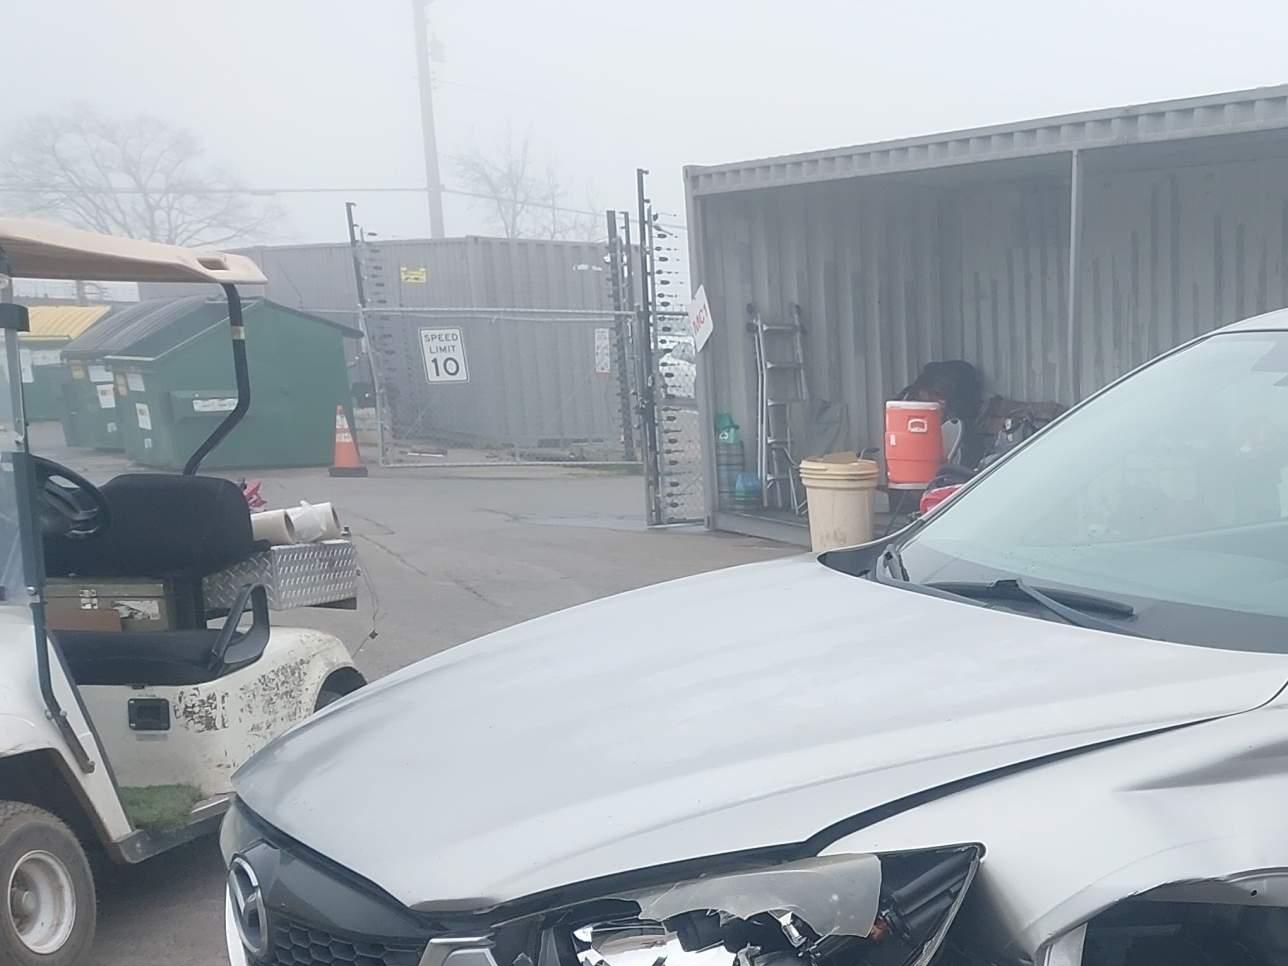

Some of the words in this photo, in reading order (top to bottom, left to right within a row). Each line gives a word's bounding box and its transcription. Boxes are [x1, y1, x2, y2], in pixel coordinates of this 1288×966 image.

[424, 333, 459, 342] SPEED
[429, 345, 456, 353] LIMIT
[431, 357, 460, 377] 10
